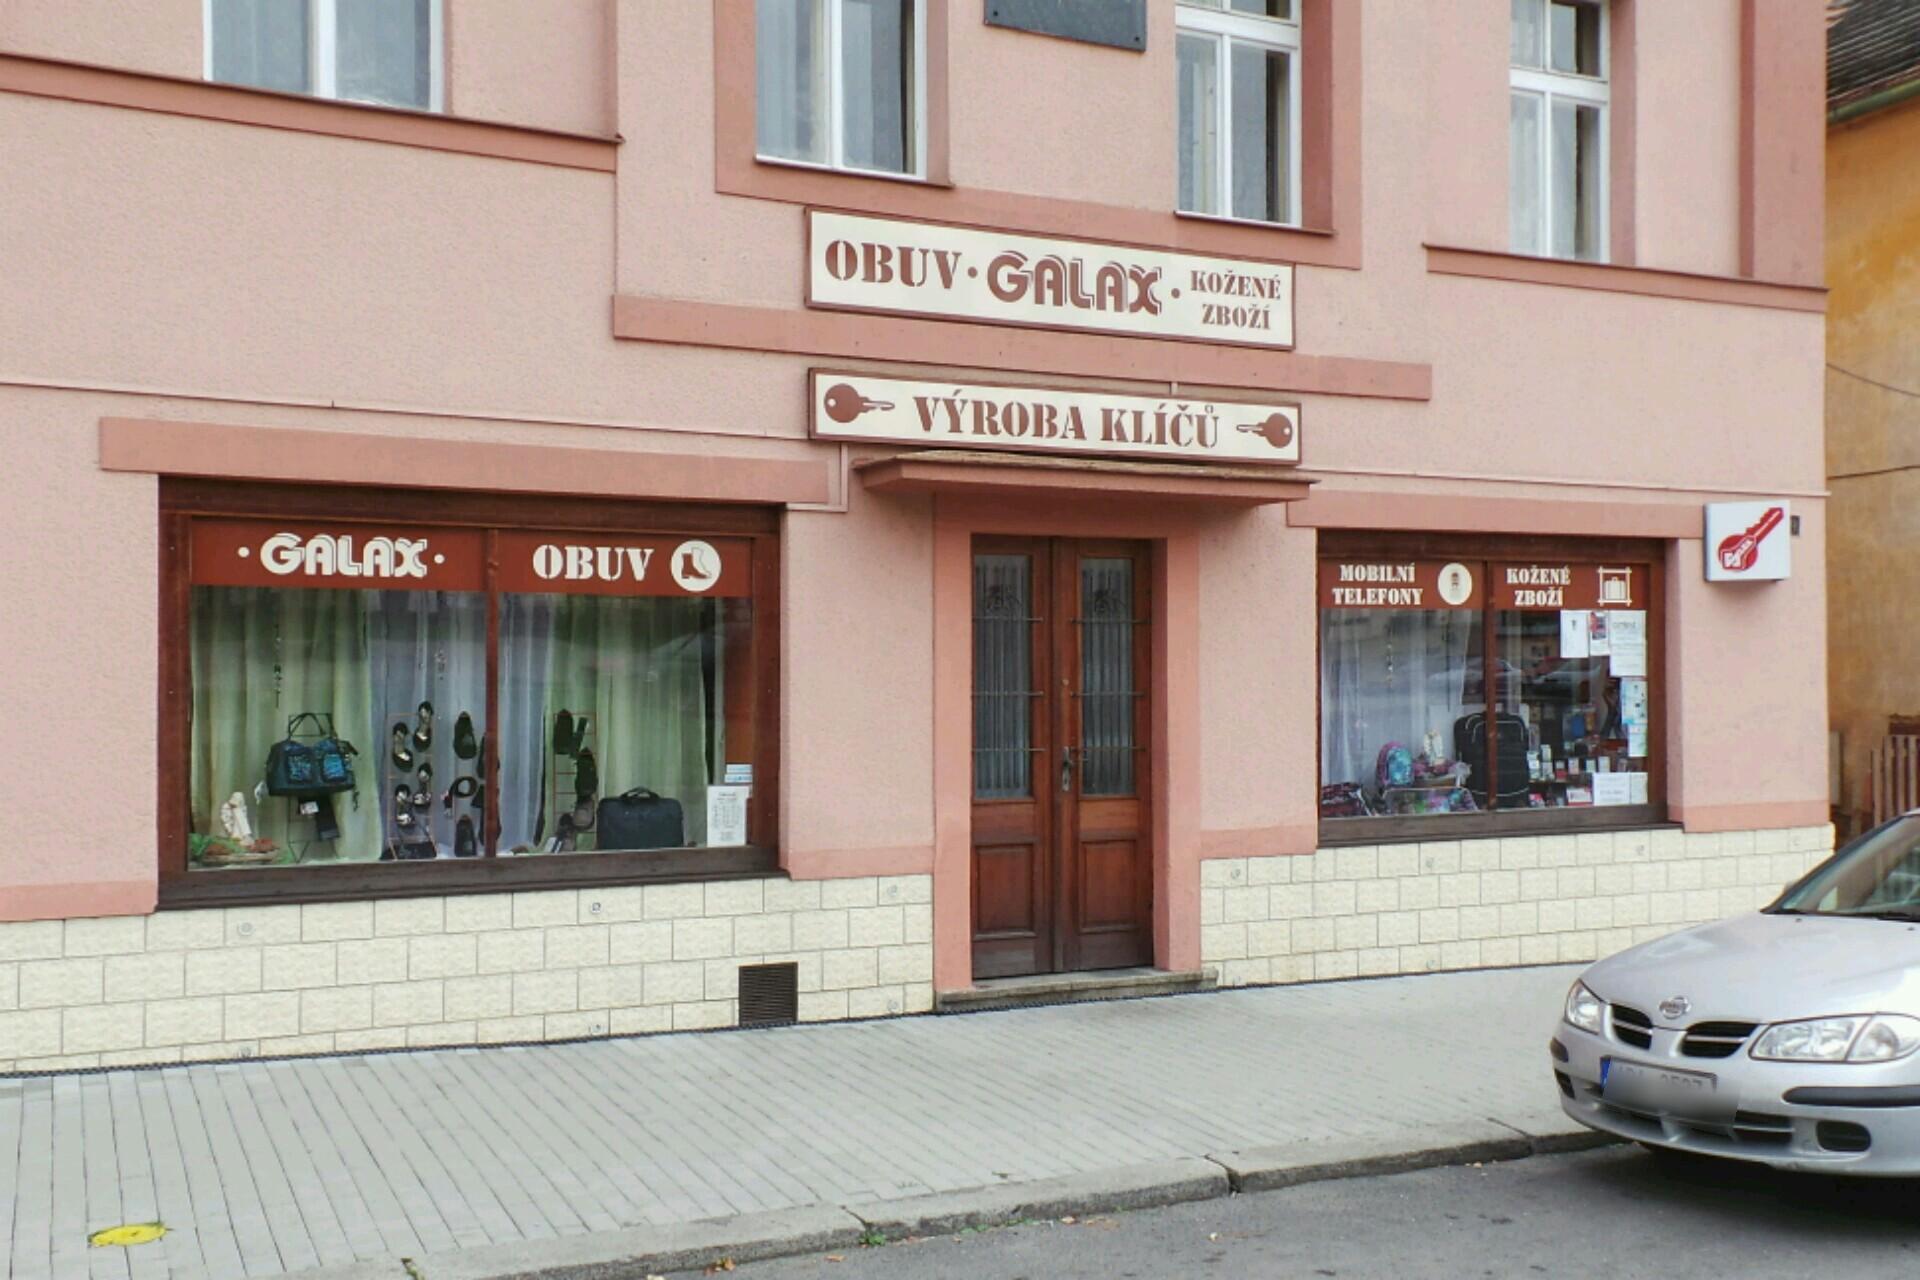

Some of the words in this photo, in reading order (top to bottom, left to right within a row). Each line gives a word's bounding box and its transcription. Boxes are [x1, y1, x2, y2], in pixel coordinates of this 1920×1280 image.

[825, 239, 962, 290] OBUV
[987, 250, 1162, 316] GALAX
[1190, 269, 1281, 301] KOŽENÉ
[1202, 302, 1271, 330] ZBOŽÍ
[914, 390, 1086, 441] VÝROBA
[1101, 403, 1220, 448] KLÍČŮ
[260, 532, 427, 578] GALAX
[533, 544, 654, 582] OBUV
[1339, 562, 1416, 583] MOBILNÍ
[1506, 564, 1571, 585] KOŽENÉ
[1332, 587, 1423, 606] TELEFONY
[1514, 586, 1564, 607] ZBOŽÍ
